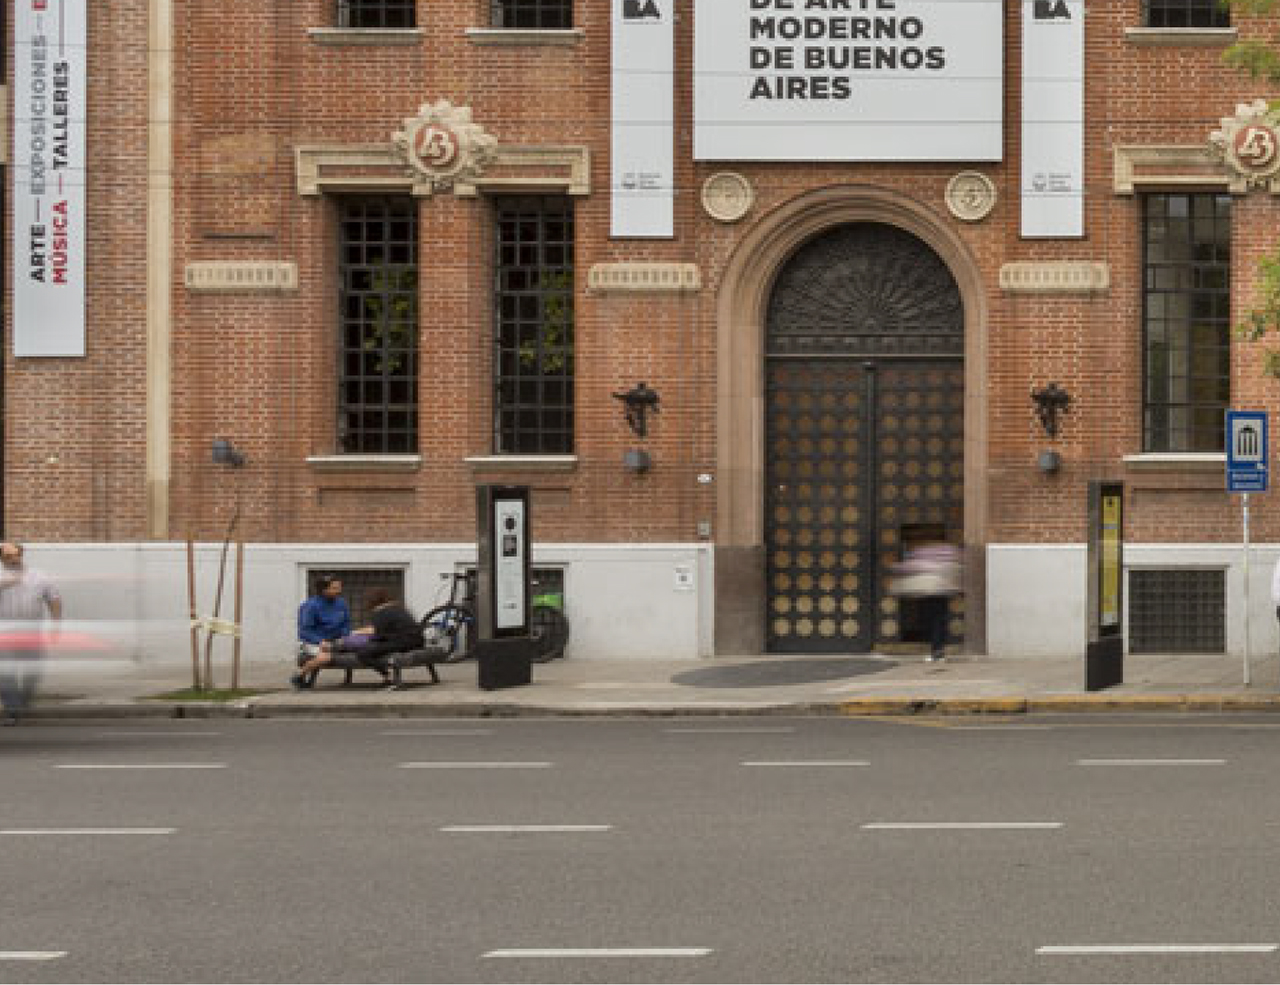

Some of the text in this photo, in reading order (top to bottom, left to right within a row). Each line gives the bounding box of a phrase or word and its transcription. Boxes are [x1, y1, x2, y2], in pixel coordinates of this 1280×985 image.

[622, 0, 661, 20] BA
[1033, 0, 1071, 20] BA
[749, 16, 923, 39] MODERNO
[749, 46, 945, 69] DE BUENOS
[749, 76, 852, 99] AIRES
[31, 34, 48, 195] EXPOSICIONES
[52, 62, 68, 170] TALLERES
[30, 225, 46, 283] ARTE
[49, 200, 68, 285] MÚSICA
